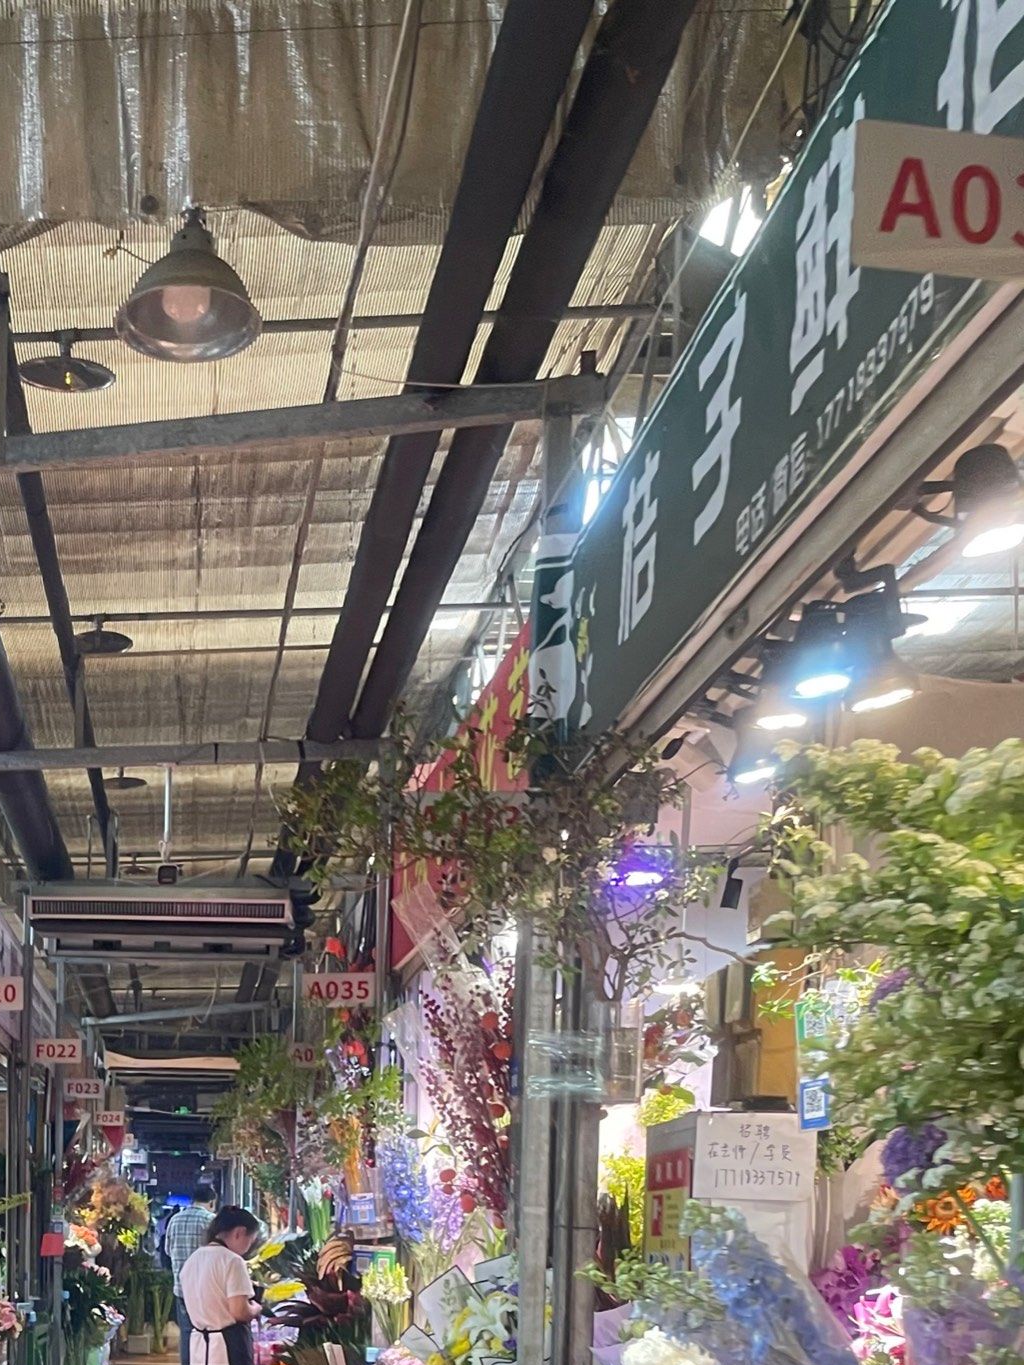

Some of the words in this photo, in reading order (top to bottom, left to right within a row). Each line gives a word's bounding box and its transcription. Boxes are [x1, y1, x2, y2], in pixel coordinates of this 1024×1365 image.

[879, 156, 1024, 246] A0
[310, 980, 370, 1000] A035
[35, 1044, 77, 1059] F022
[67, 1083, 100, 1094] F023
[96, 1114, 121, 1123] F024
[739, 1124, 771, 1141] 招聘
